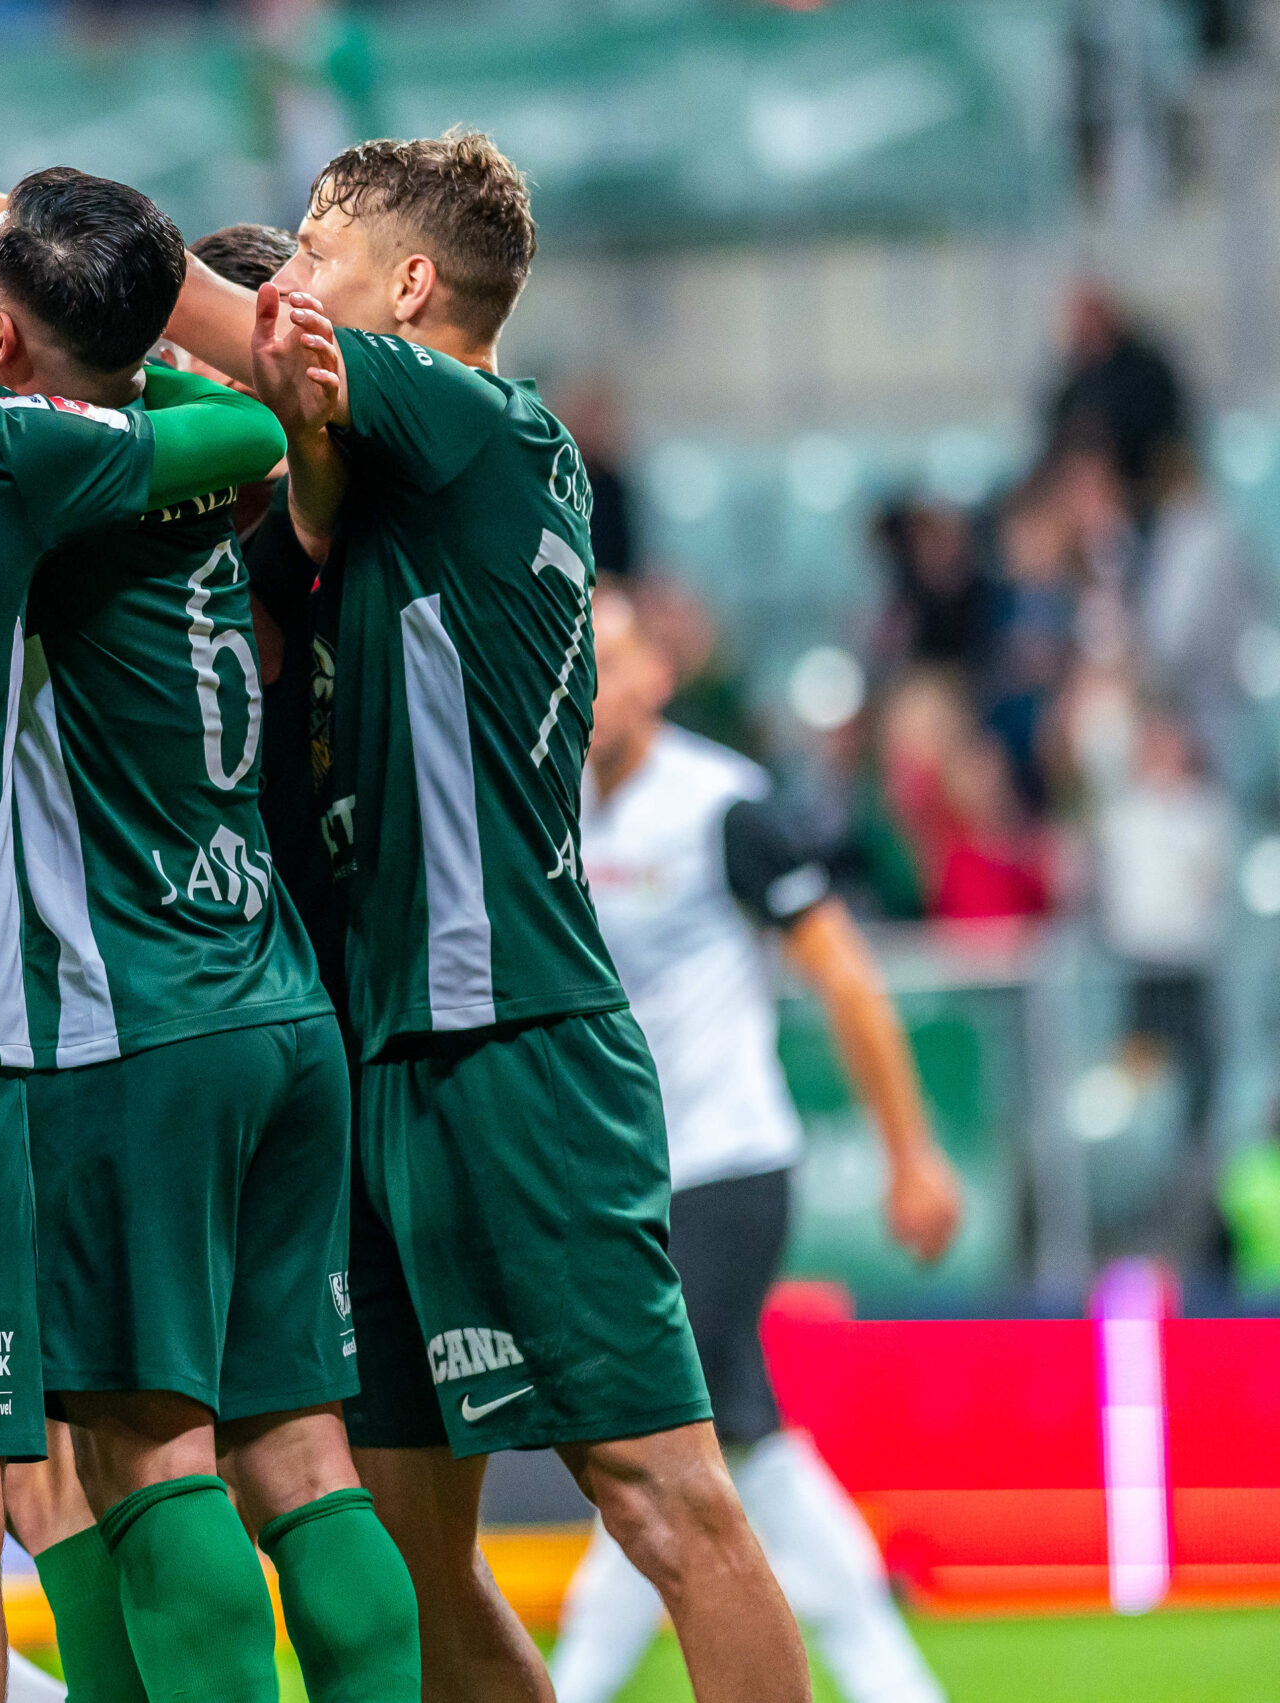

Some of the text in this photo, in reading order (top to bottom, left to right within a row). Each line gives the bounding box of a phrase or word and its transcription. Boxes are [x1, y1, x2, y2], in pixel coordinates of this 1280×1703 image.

[186, 539, 263, 790] 6
[531, 528, 594, 768] 7
[152, 824, 273, 922] JAX
